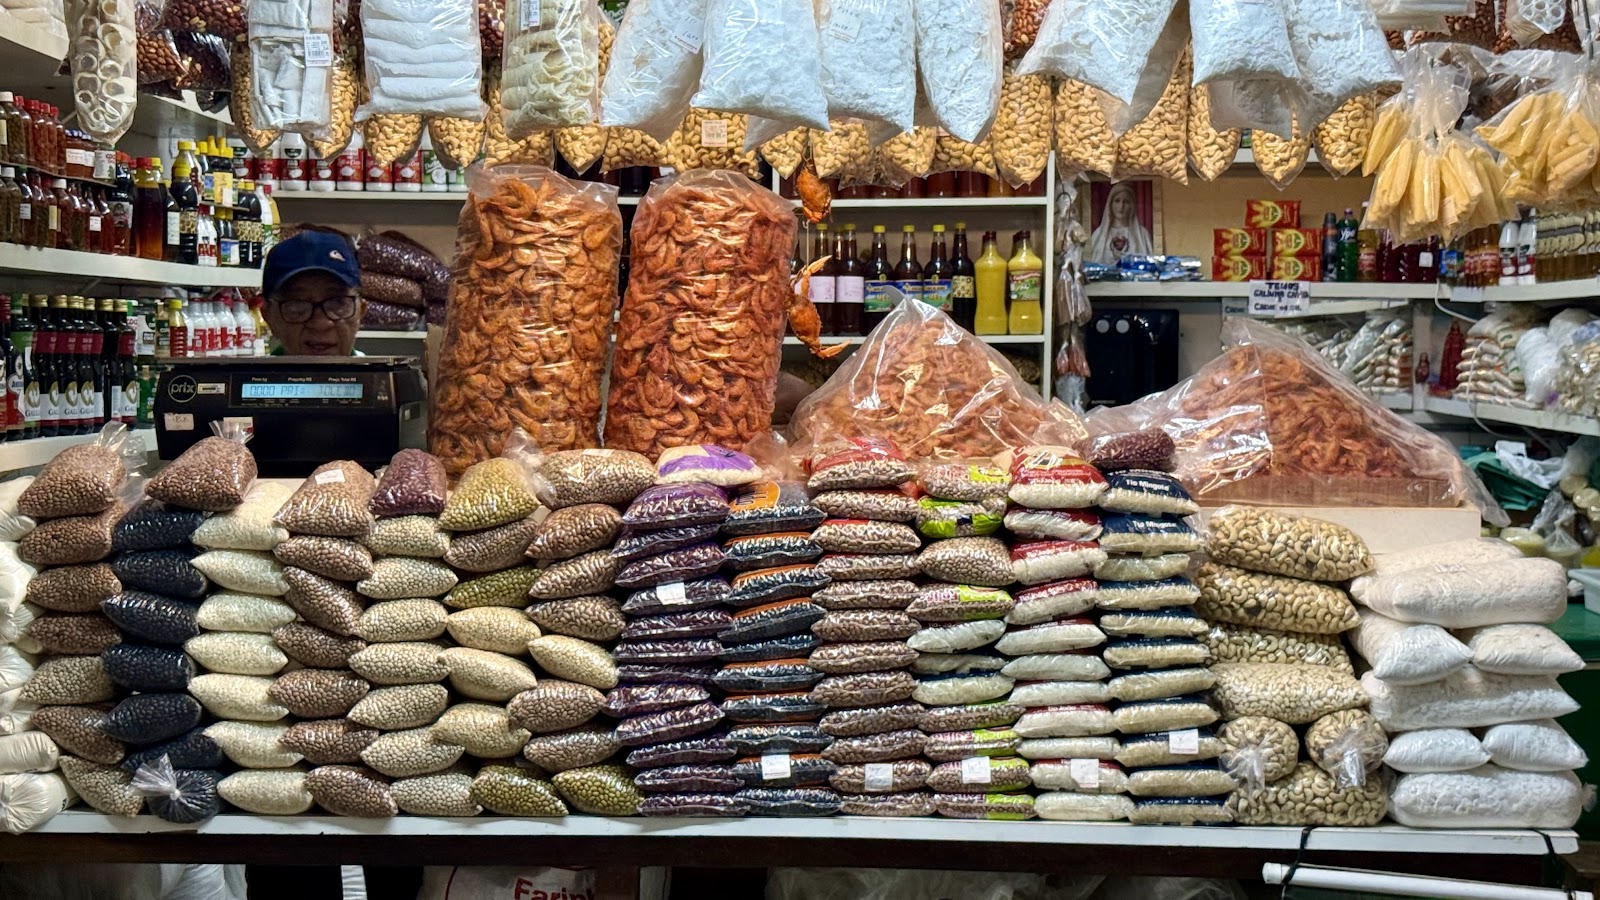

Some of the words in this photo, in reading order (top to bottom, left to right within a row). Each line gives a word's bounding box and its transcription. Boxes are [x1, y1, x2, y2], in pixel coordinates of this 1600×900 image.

[171, 381, 195, 395] prix
[1125, 479, 1138, 487] Tio
[1139, 480, 1170, 492] Mingote
